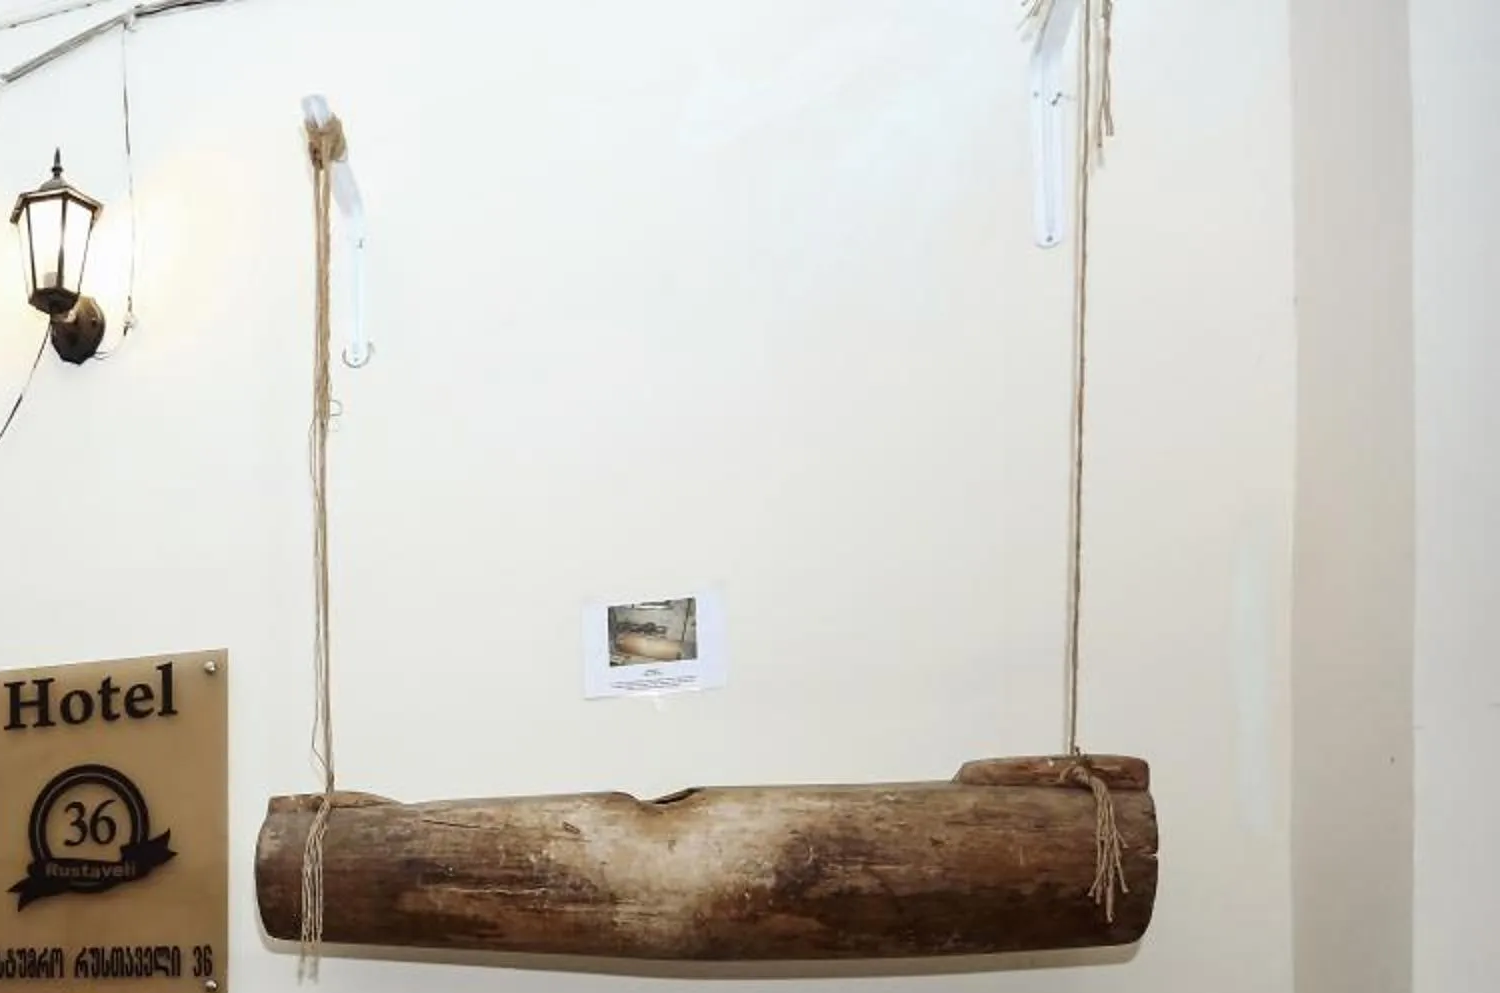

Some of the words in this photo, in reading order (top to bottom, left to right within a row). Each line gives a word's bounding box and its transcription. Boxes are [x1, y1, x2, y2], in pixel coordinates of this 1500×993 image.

[3, 661, 179, 731] Hotel
[63, 799, 118, 847] 36
[45, 863, 136, 878] Rustaveli
[193, 944, 213, 977] 36
